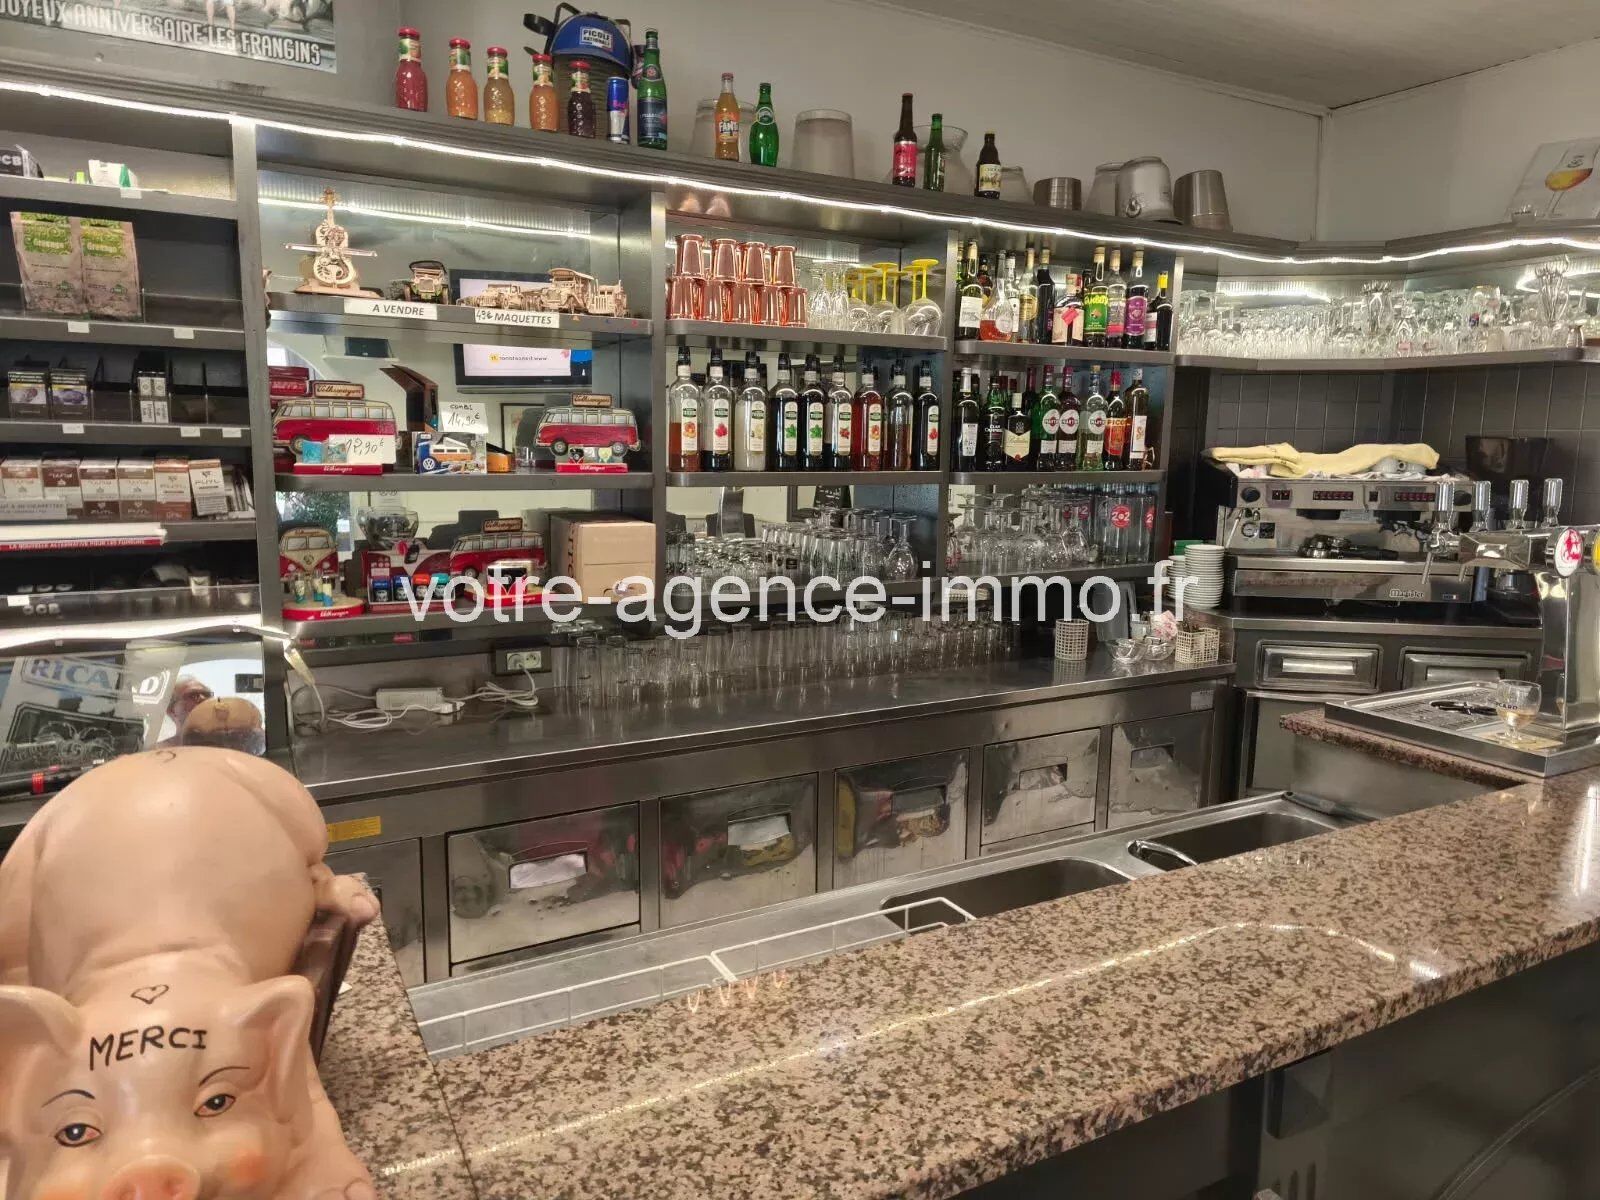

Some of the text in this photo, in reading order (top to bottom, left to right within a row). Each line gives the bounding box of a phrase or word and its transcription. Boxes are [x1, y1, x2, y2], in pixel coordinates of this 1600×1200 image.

[73, 3, 202, 45] ANNIVERSAIRE
[207, 26, 236, 49] LES
[241, 31, 322, 66] FRANGINS
[719, 120, 739, 134] FANT
[0, 154, 22, 167] CB
[372, 304, 425, 316] A VENDRE
[494, 313, 552, 325] MAQUETTES
[88, 1024, 208, 1072] MERCI
